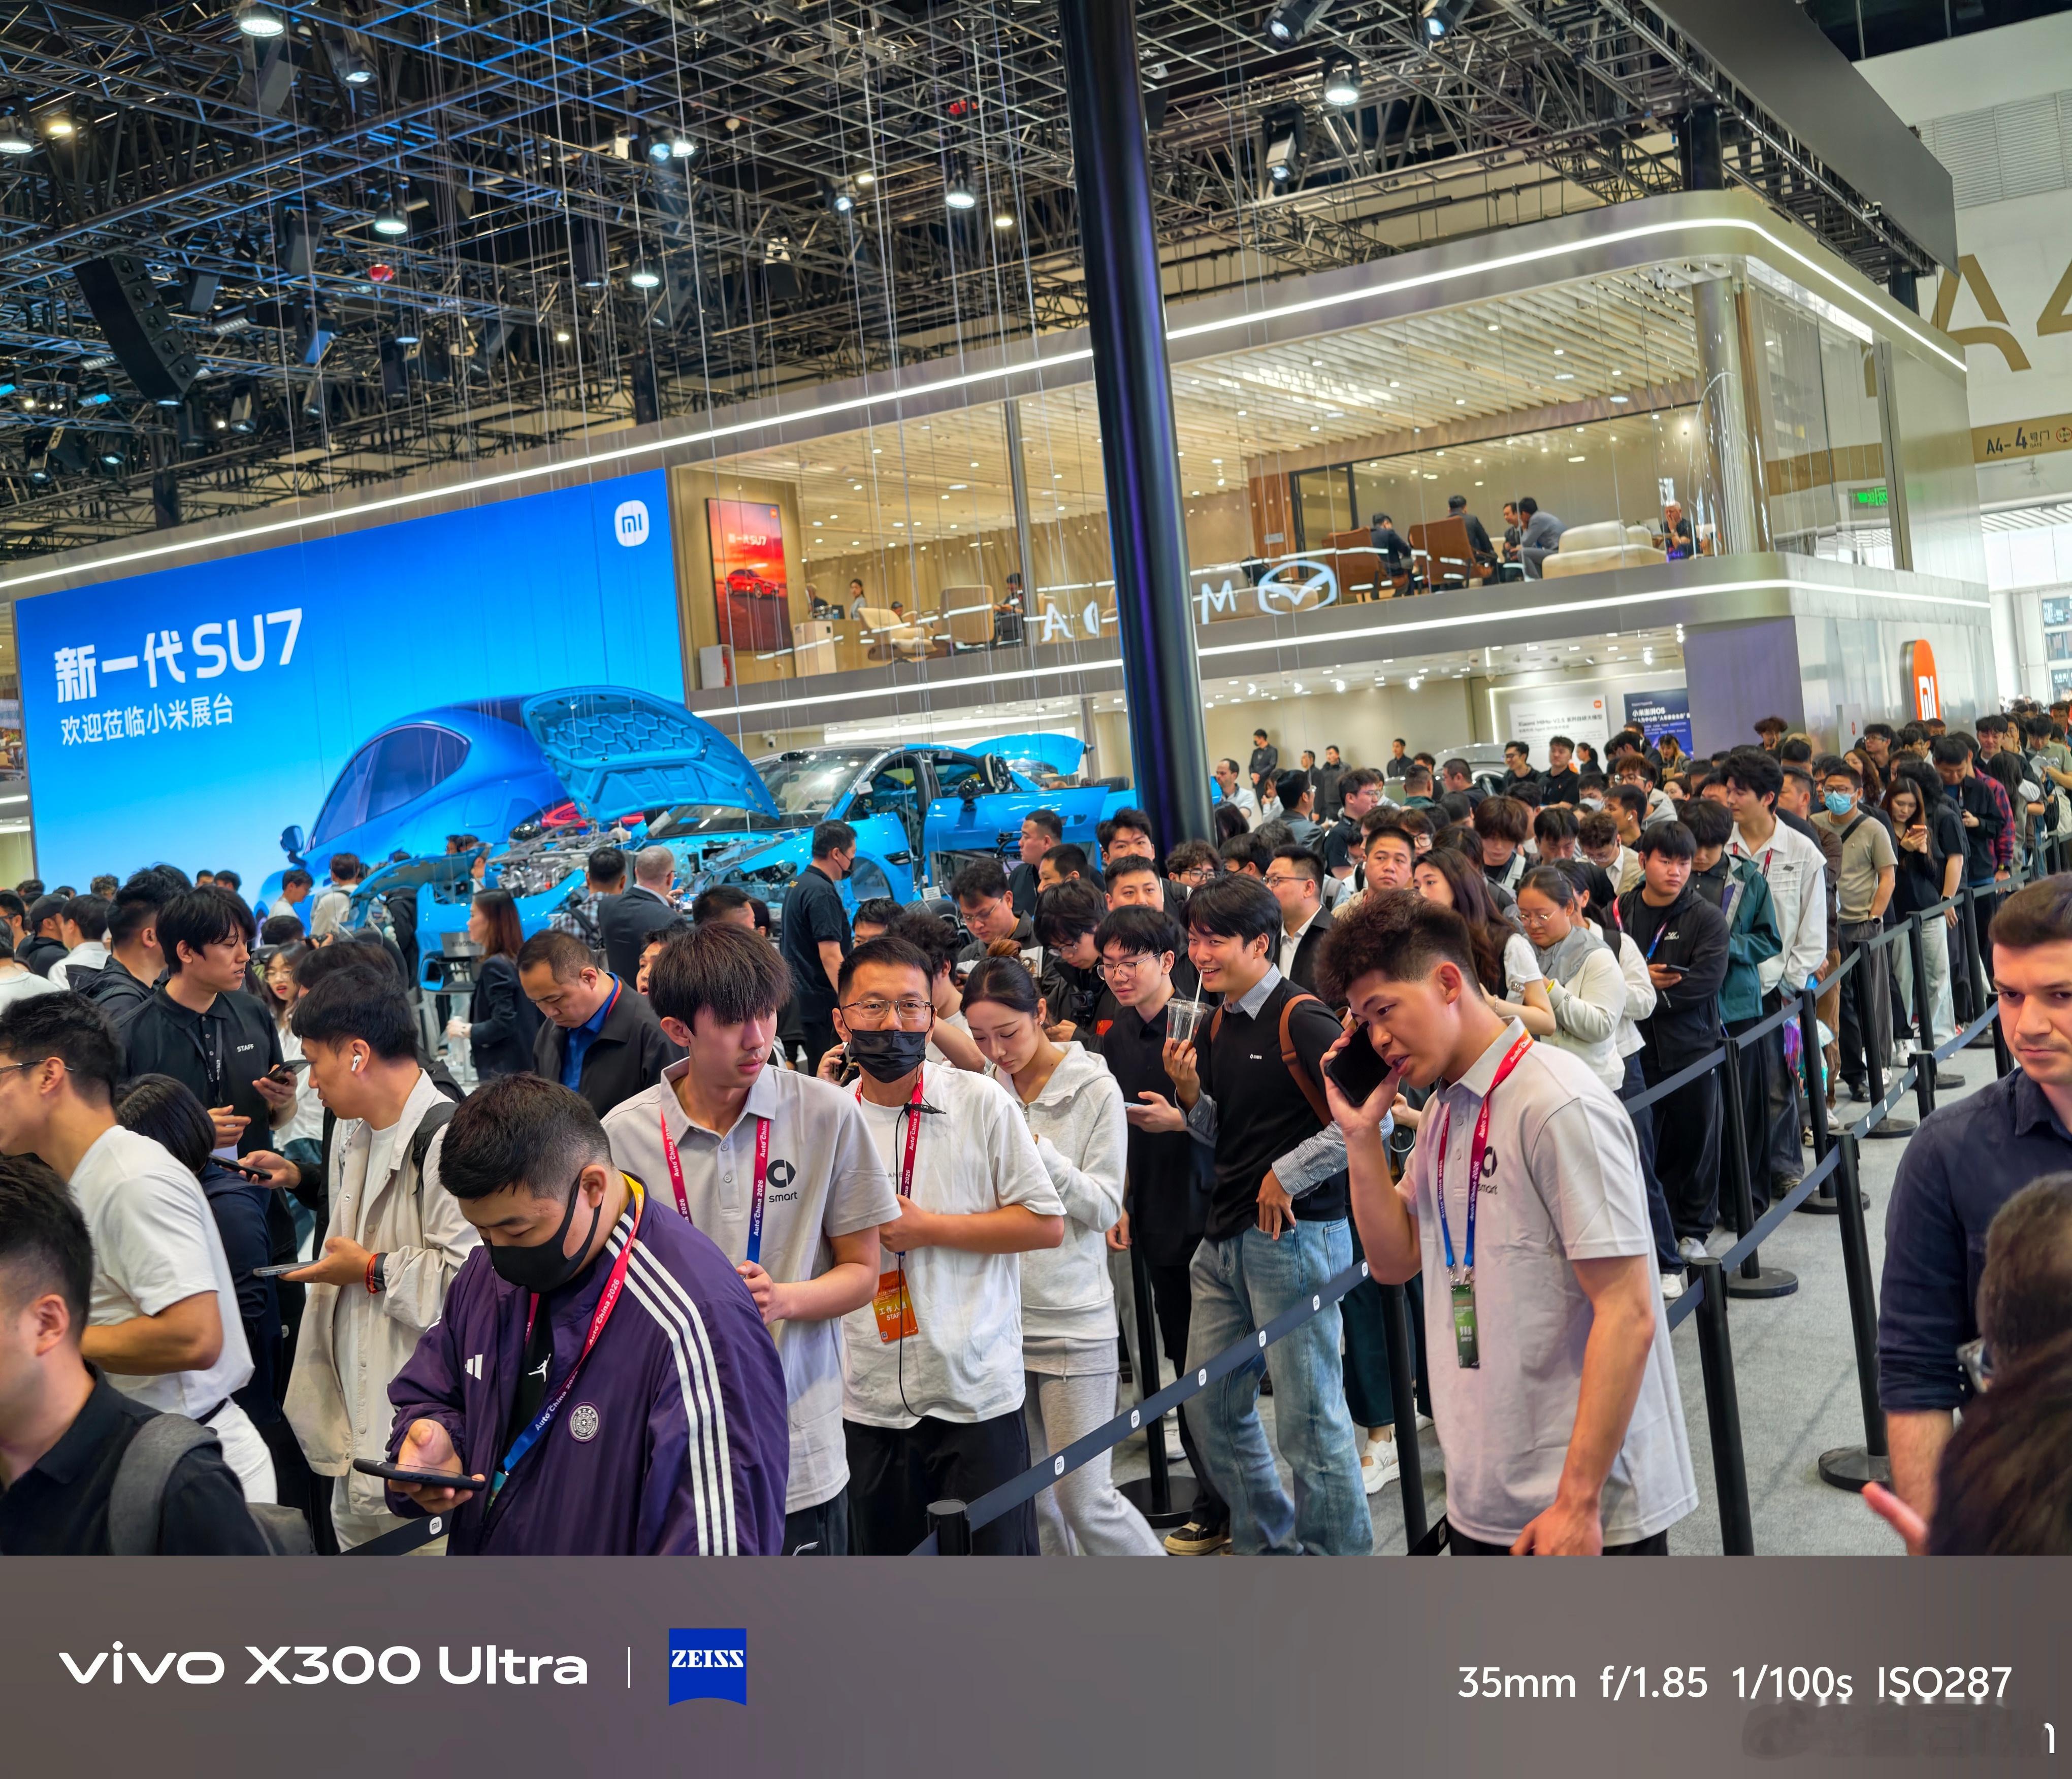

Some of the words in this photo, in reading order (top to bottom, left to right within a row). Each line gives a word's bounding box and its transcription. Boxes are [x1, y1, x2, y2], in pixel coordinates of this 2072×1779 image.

[61, 693, 234, 747] 欢迎莅临小米展台
[237, 1043, 254, 1052] STAFF
[1477, 1183, 1498, 1195] smart
[769, 1191, 797, 1203] smart
[679, 1198, 688, 1215] 2026
[588, 1325, 599, 1345] Auto
[596, 1300, 611, 1325] China
[607, 1278, 620, 1300] 2026
[886, 1312, 901, 1321] STAF
[535, 1413, 551, 1431] Auto
[548, 1391, 567, 1412] China
